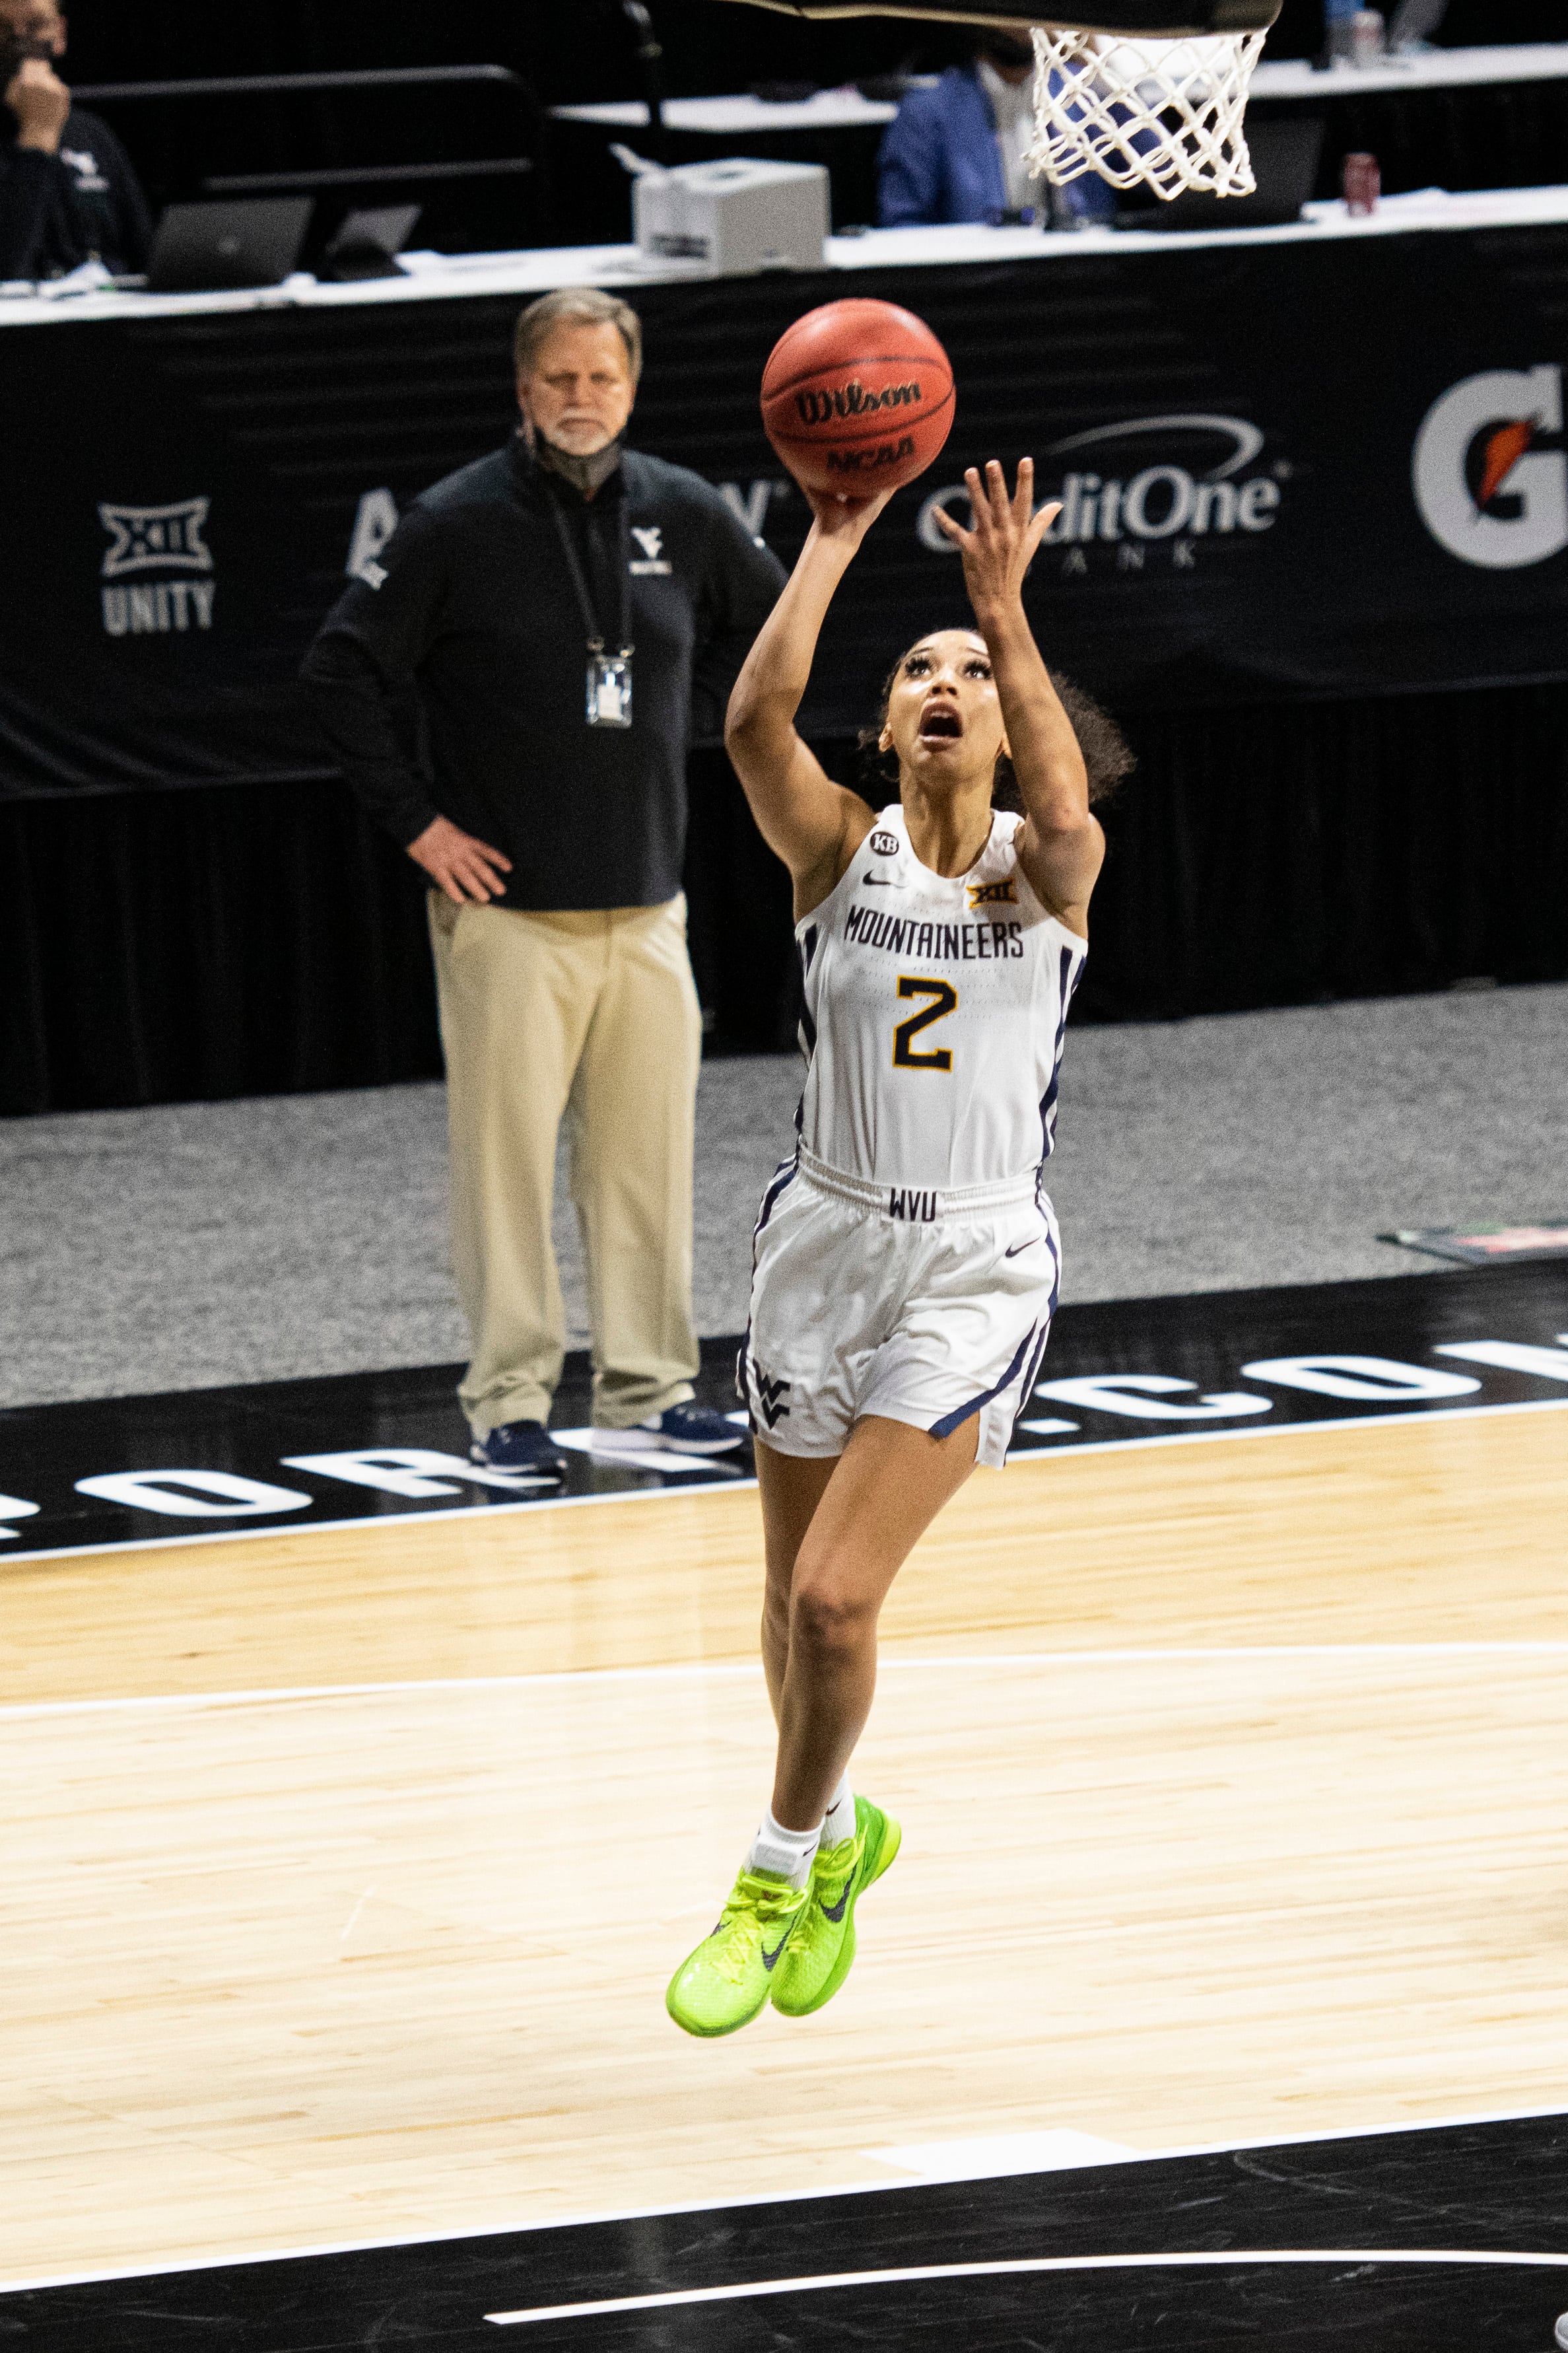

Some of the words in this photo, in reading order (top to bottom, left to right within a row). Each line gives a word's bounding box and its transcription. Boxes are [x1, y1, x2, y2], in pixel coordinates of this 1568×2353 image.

[796, 379, 922, 425] Wilson
[826, 436, 915, 470] NCAA
[1412, 364, 1568, 569] G
[1027, 538, 1197, 579] ANK
[102, 580, 215, 636] UNITY
[872, 834, 899, 853] KB
[844, 905, 1023, 960] MOUNTAINEERS
[893, 975, 958, 1072] 2
[889, 1187, 937, 1222] WVU
